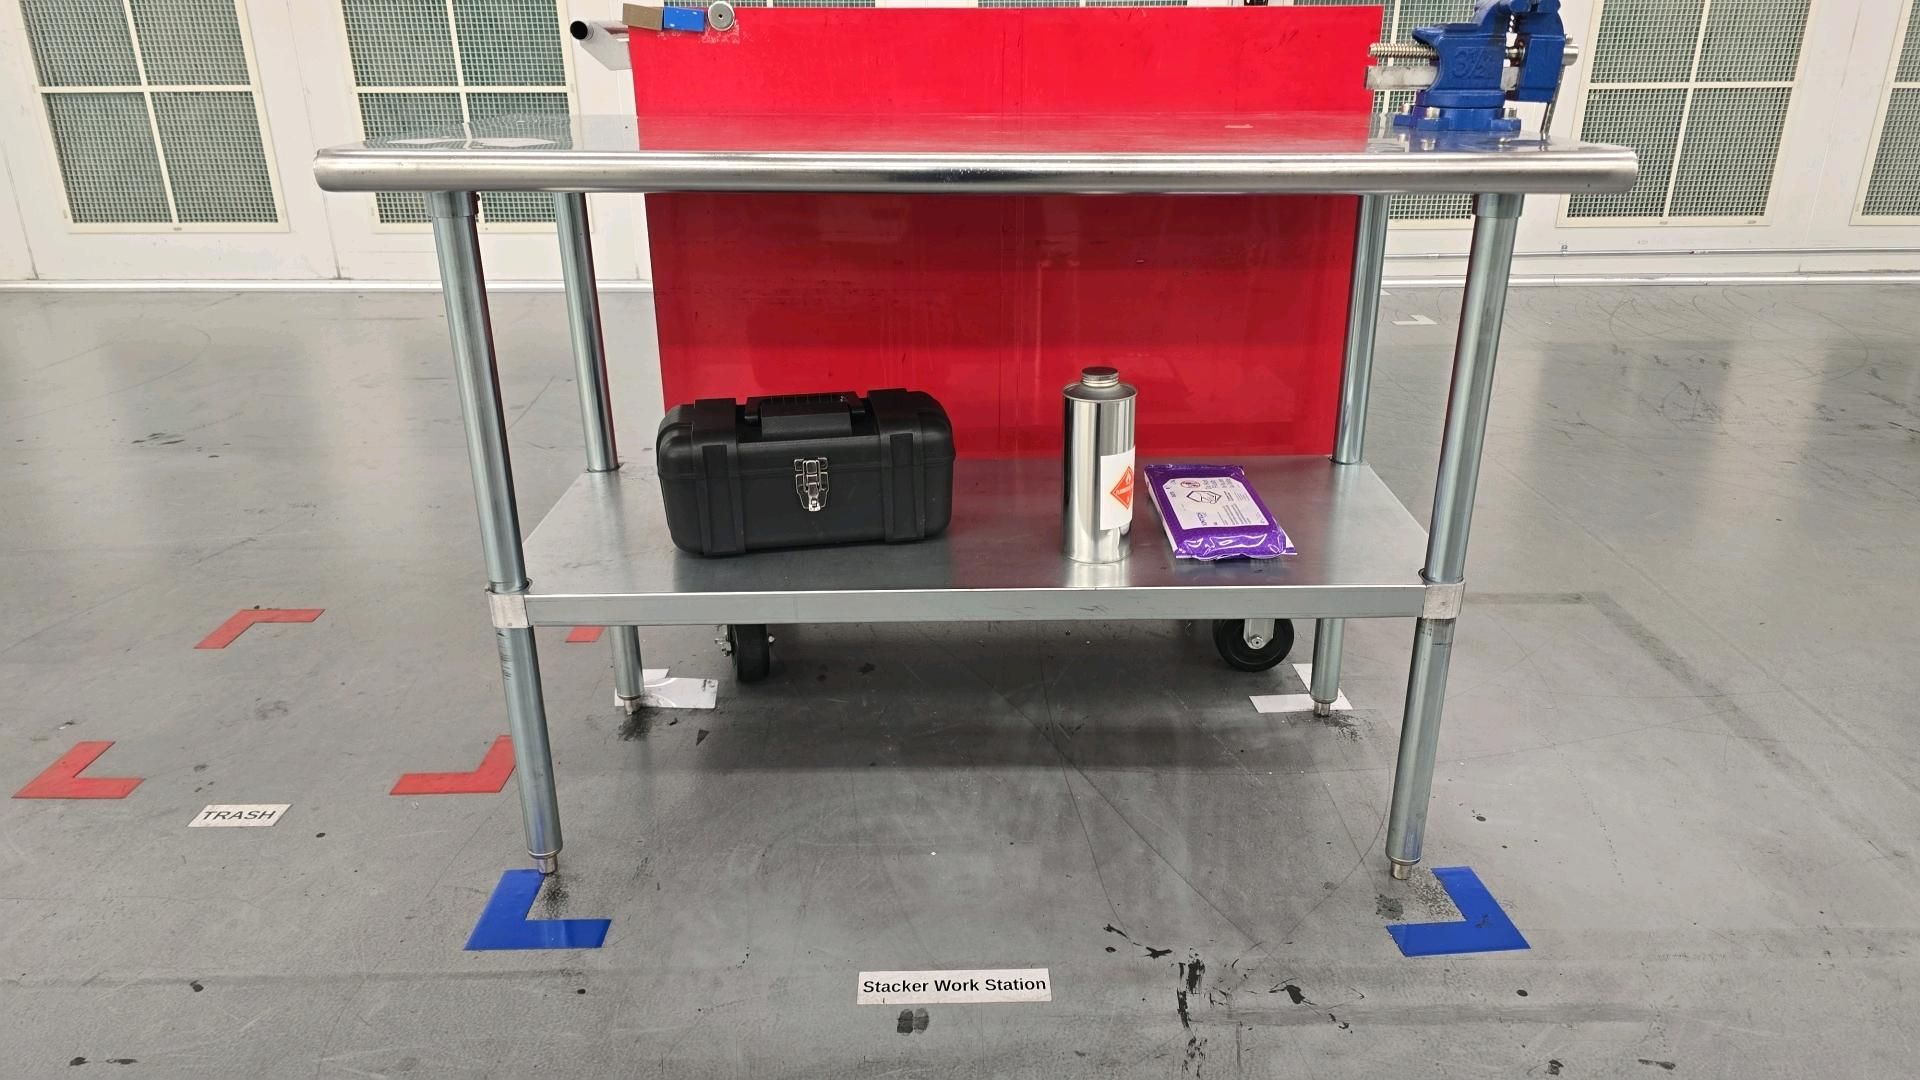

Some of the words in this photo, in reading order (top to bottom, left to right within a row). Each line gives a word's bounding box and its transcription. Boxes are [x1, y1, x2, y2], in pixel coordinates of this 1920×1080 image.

[203, 811, 276, 820] TRASH
[863, 979, 929, 993] Stacker
[934, 978, 979, 992] Work
[985, 977, 1046, 991] Station
